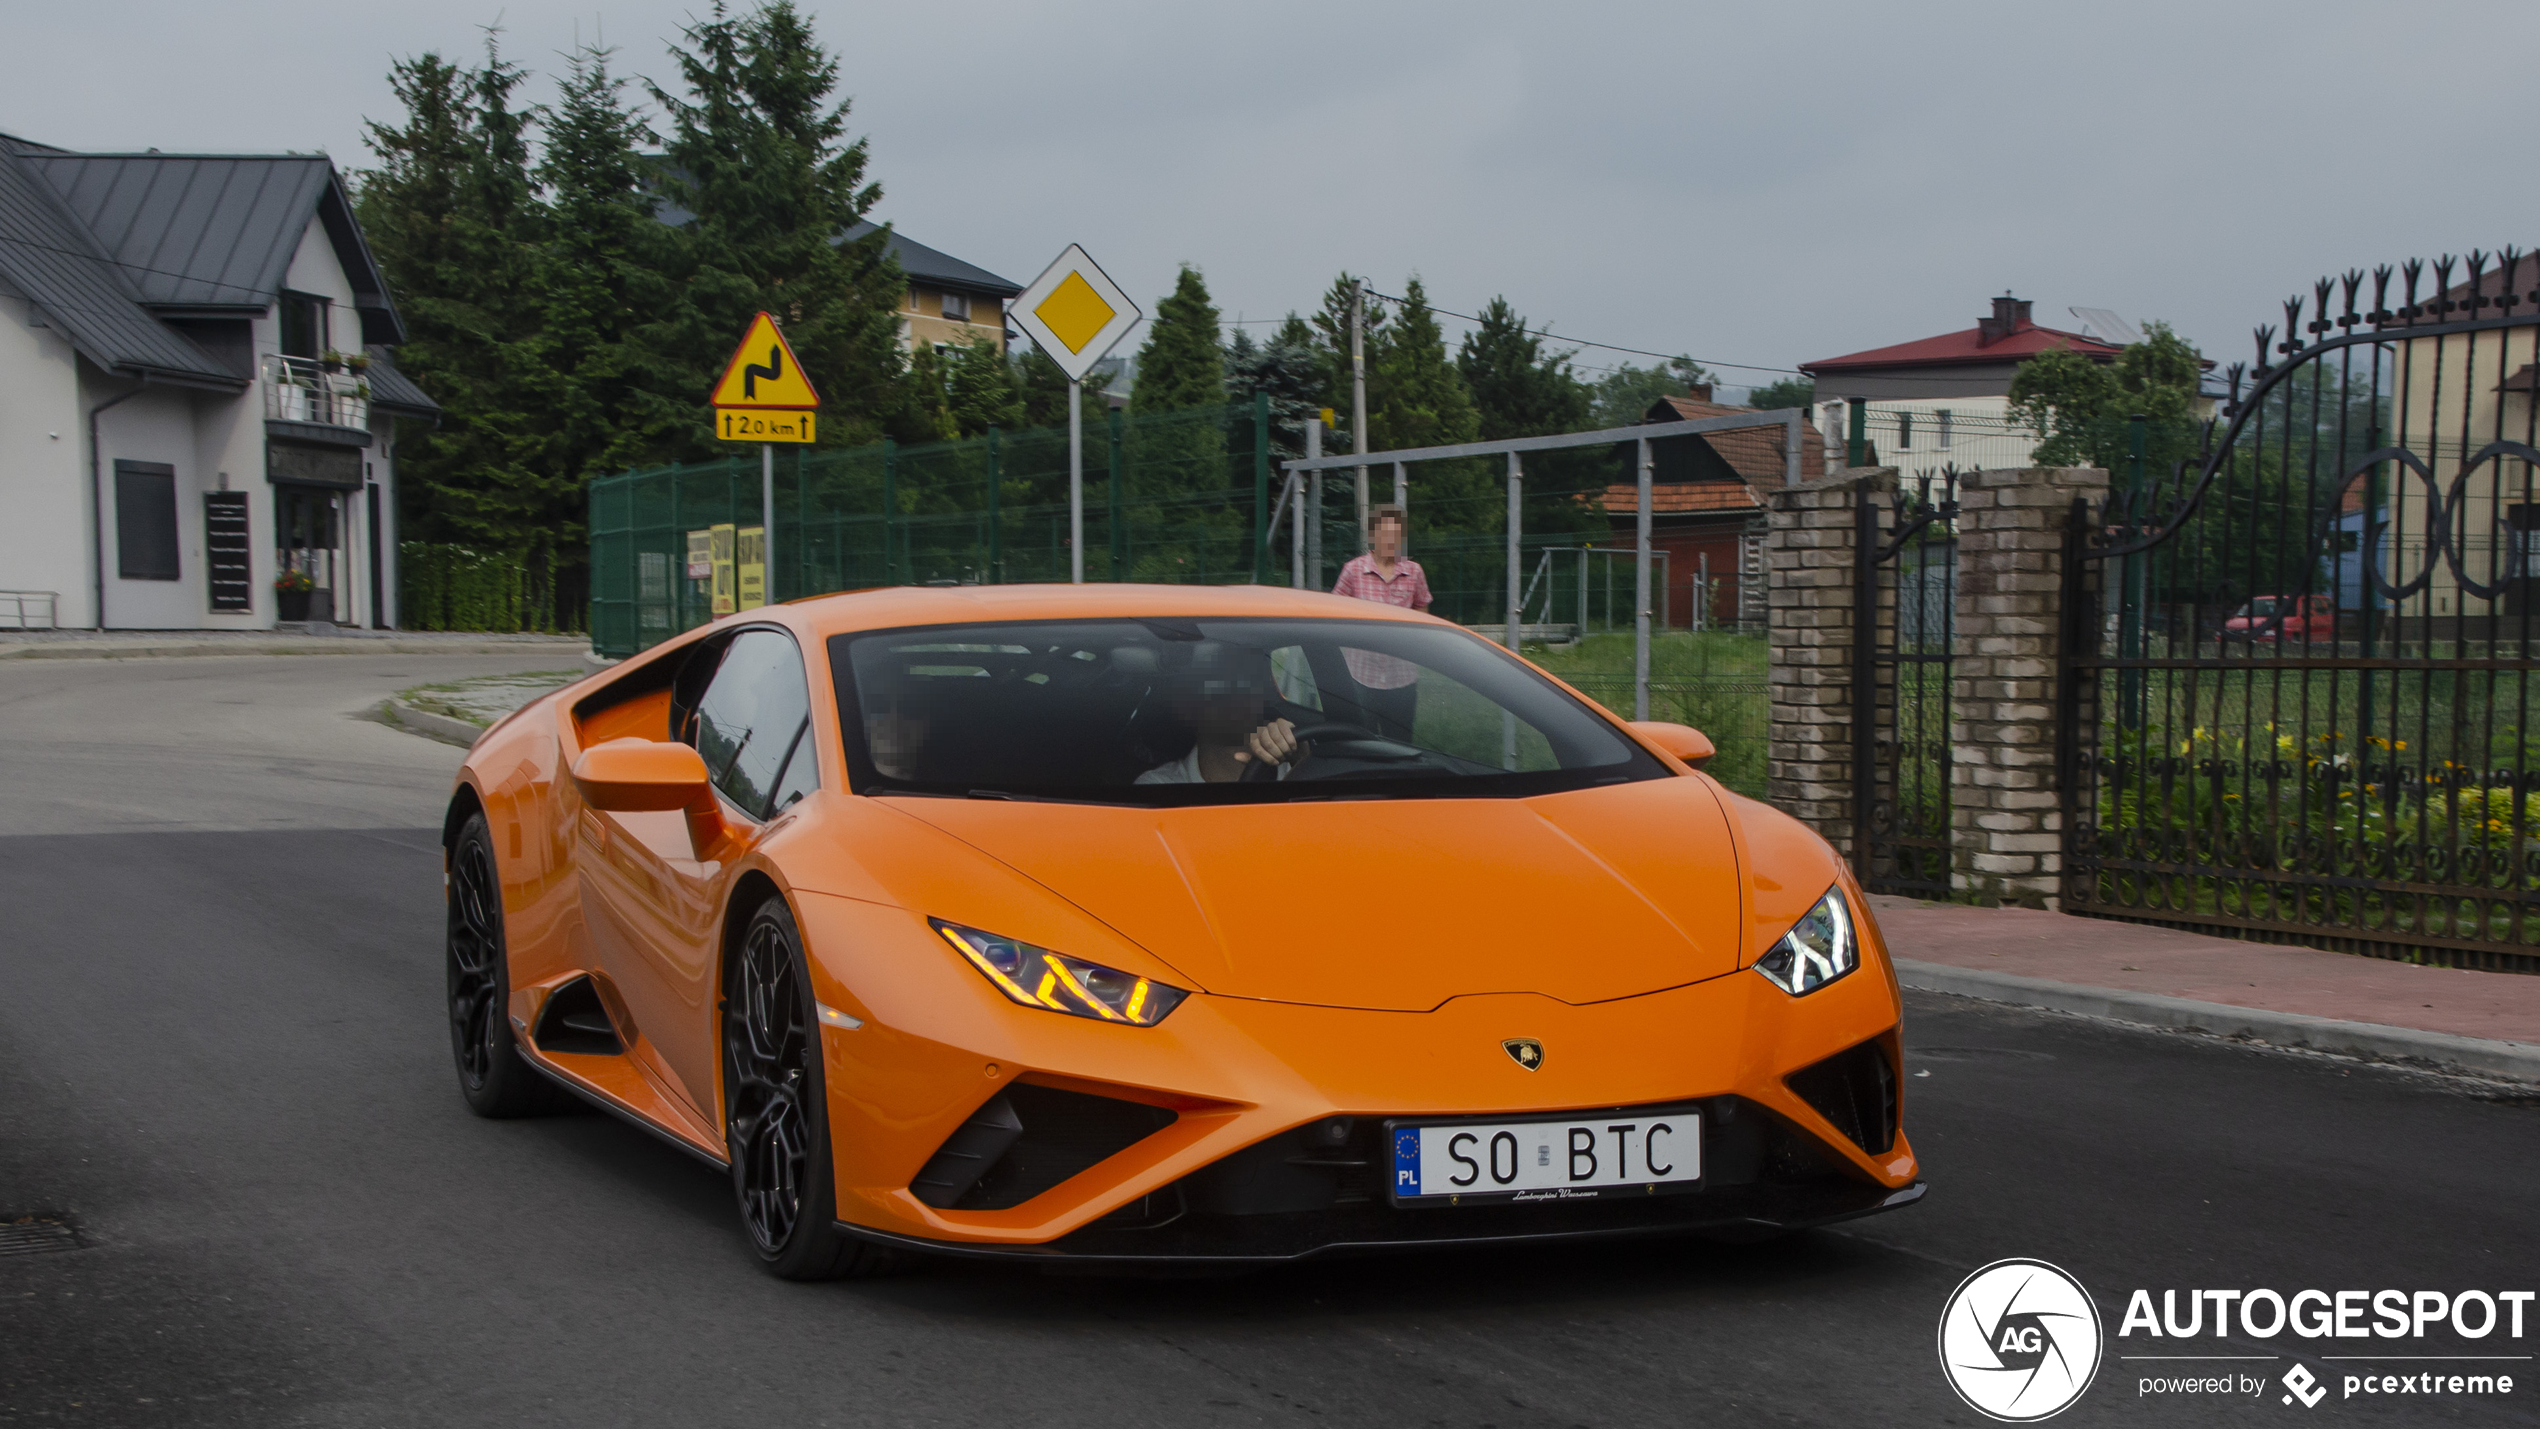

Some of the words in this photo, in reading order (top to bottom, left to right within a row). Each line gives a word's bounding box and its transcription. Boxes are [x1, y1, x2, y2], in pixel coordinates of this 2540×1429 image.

[769, 420, 795, 435] km
[1568, 1122, 1673, 1181] BTC
[1399, 1171, 1417, 1185] PL
[1512, 1190, 1557, 1201] Lamborghini
[1558, 1188, 1598, 1198] Warszawa
